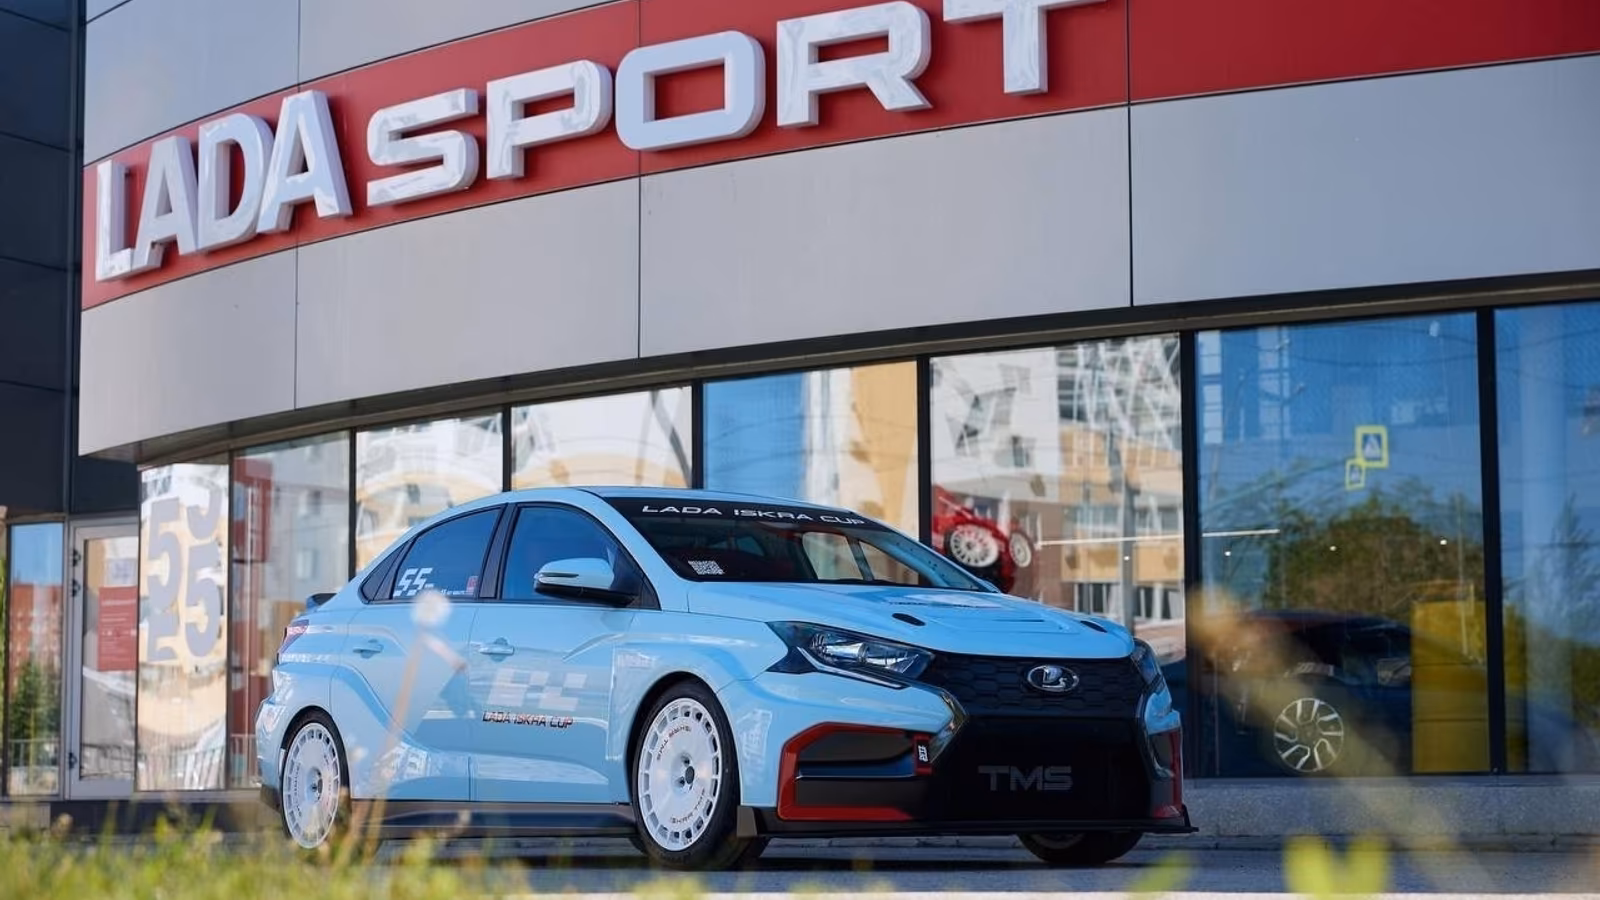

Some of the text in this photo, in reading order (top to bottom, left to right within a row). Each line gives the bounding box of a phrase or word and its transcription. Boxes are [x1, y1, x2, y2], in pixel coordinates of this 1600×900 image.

[95, 0, 1108, 282] LADA SPORT
[642, 505, 865, 525] LADA ISKRA CUP
[393, 568, 433, 597] 55
[483, 711, 574, 728] LADA ISKRA CUP
[978, 765, 1074, 791] TMS
